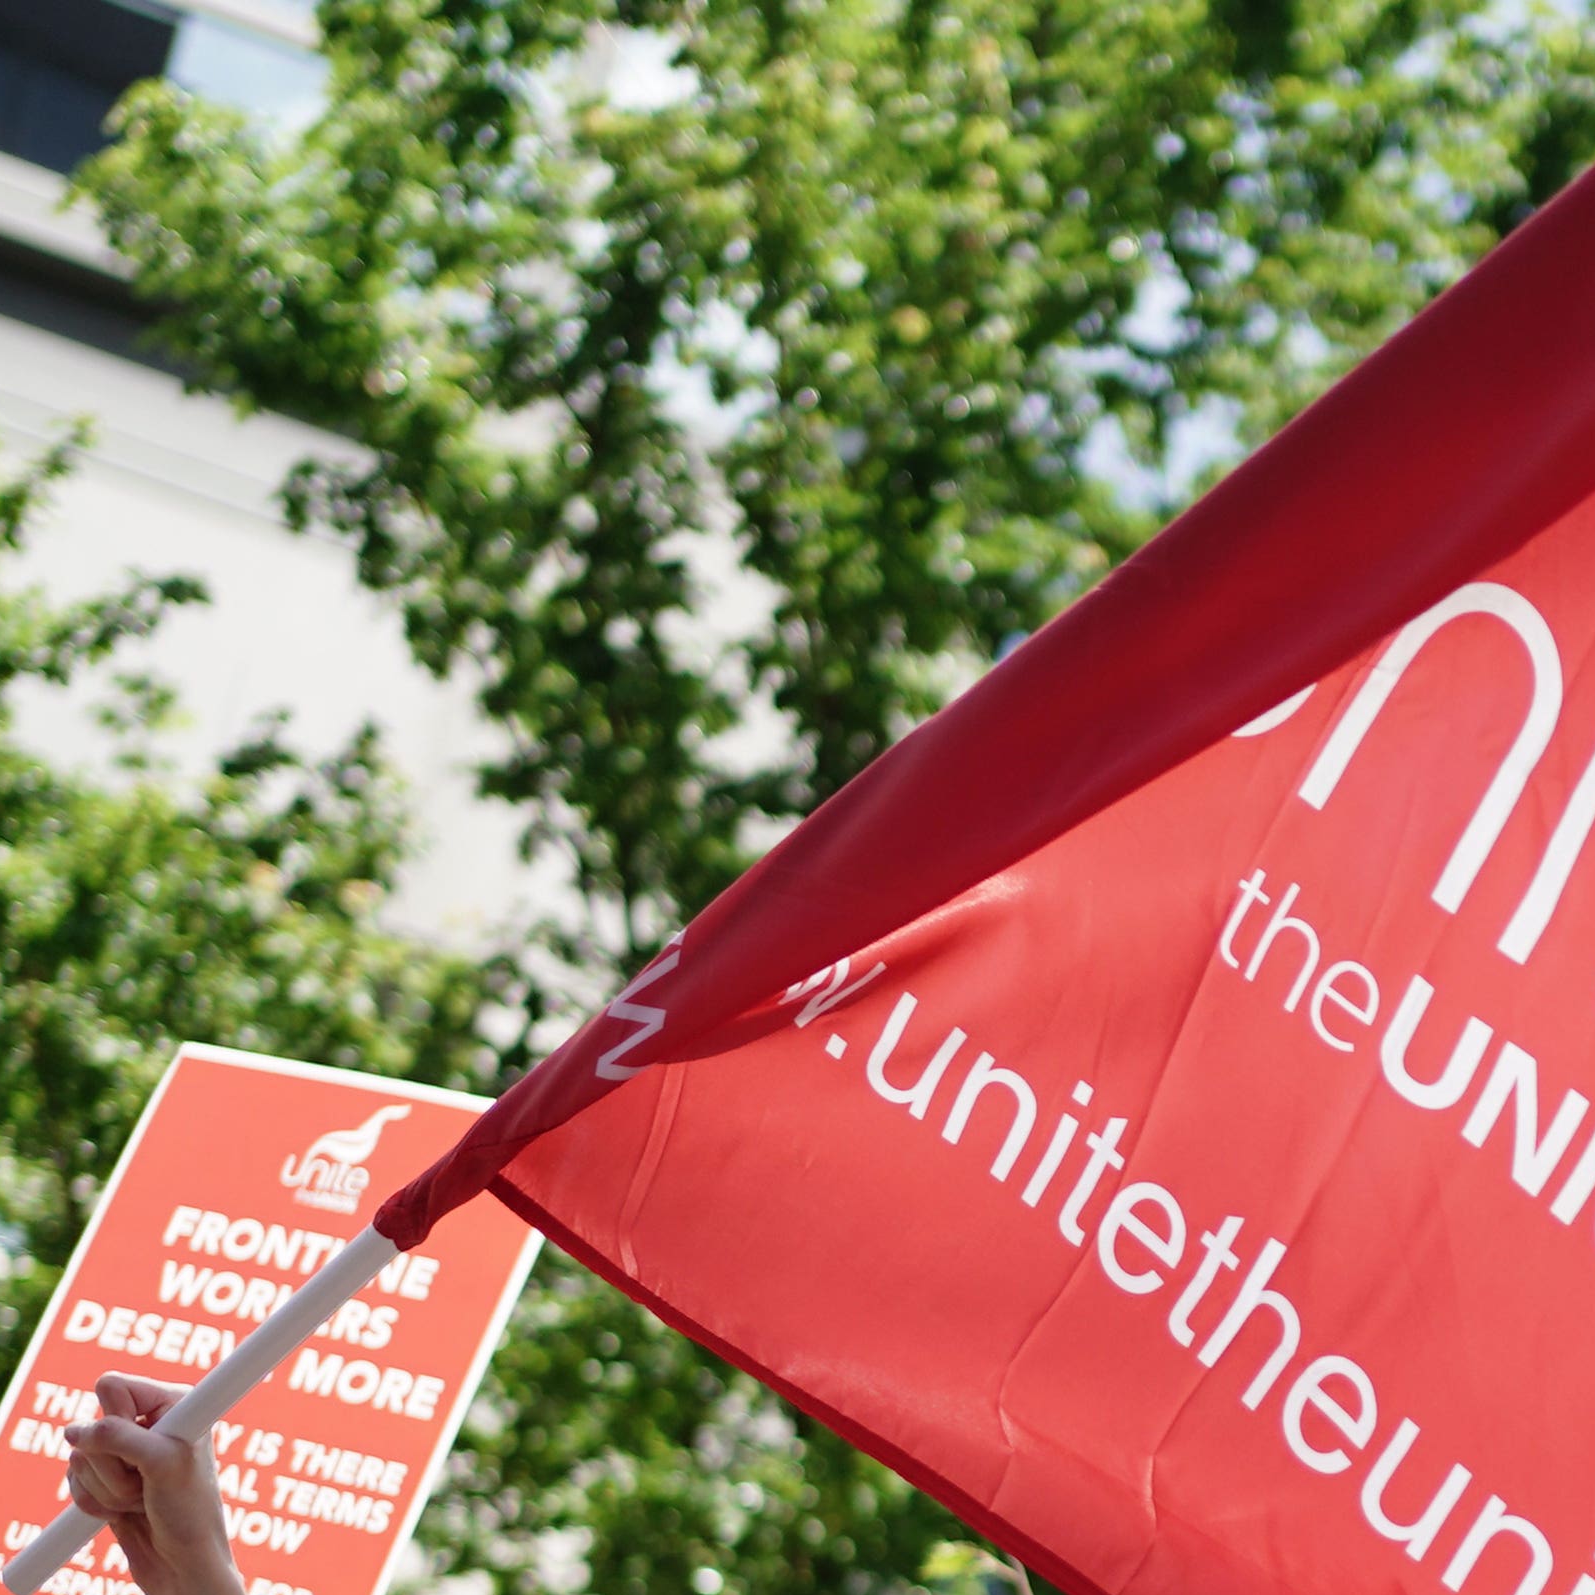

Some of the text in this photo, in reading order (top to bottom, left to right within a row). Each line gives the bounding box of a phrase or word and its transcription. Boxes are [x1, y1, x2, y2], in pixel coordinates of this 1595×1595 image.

[163, 1205, 441, 1301] FRONTNE
[158, 1260, 399, 1350] WORRS
[64, 1299, 445, 1421] DESER MORE
[243, 1428, 284, 1467] IS
[289, 1437, 409, 1497] THERE
[271, 1474, 395, 1535] TERMS
